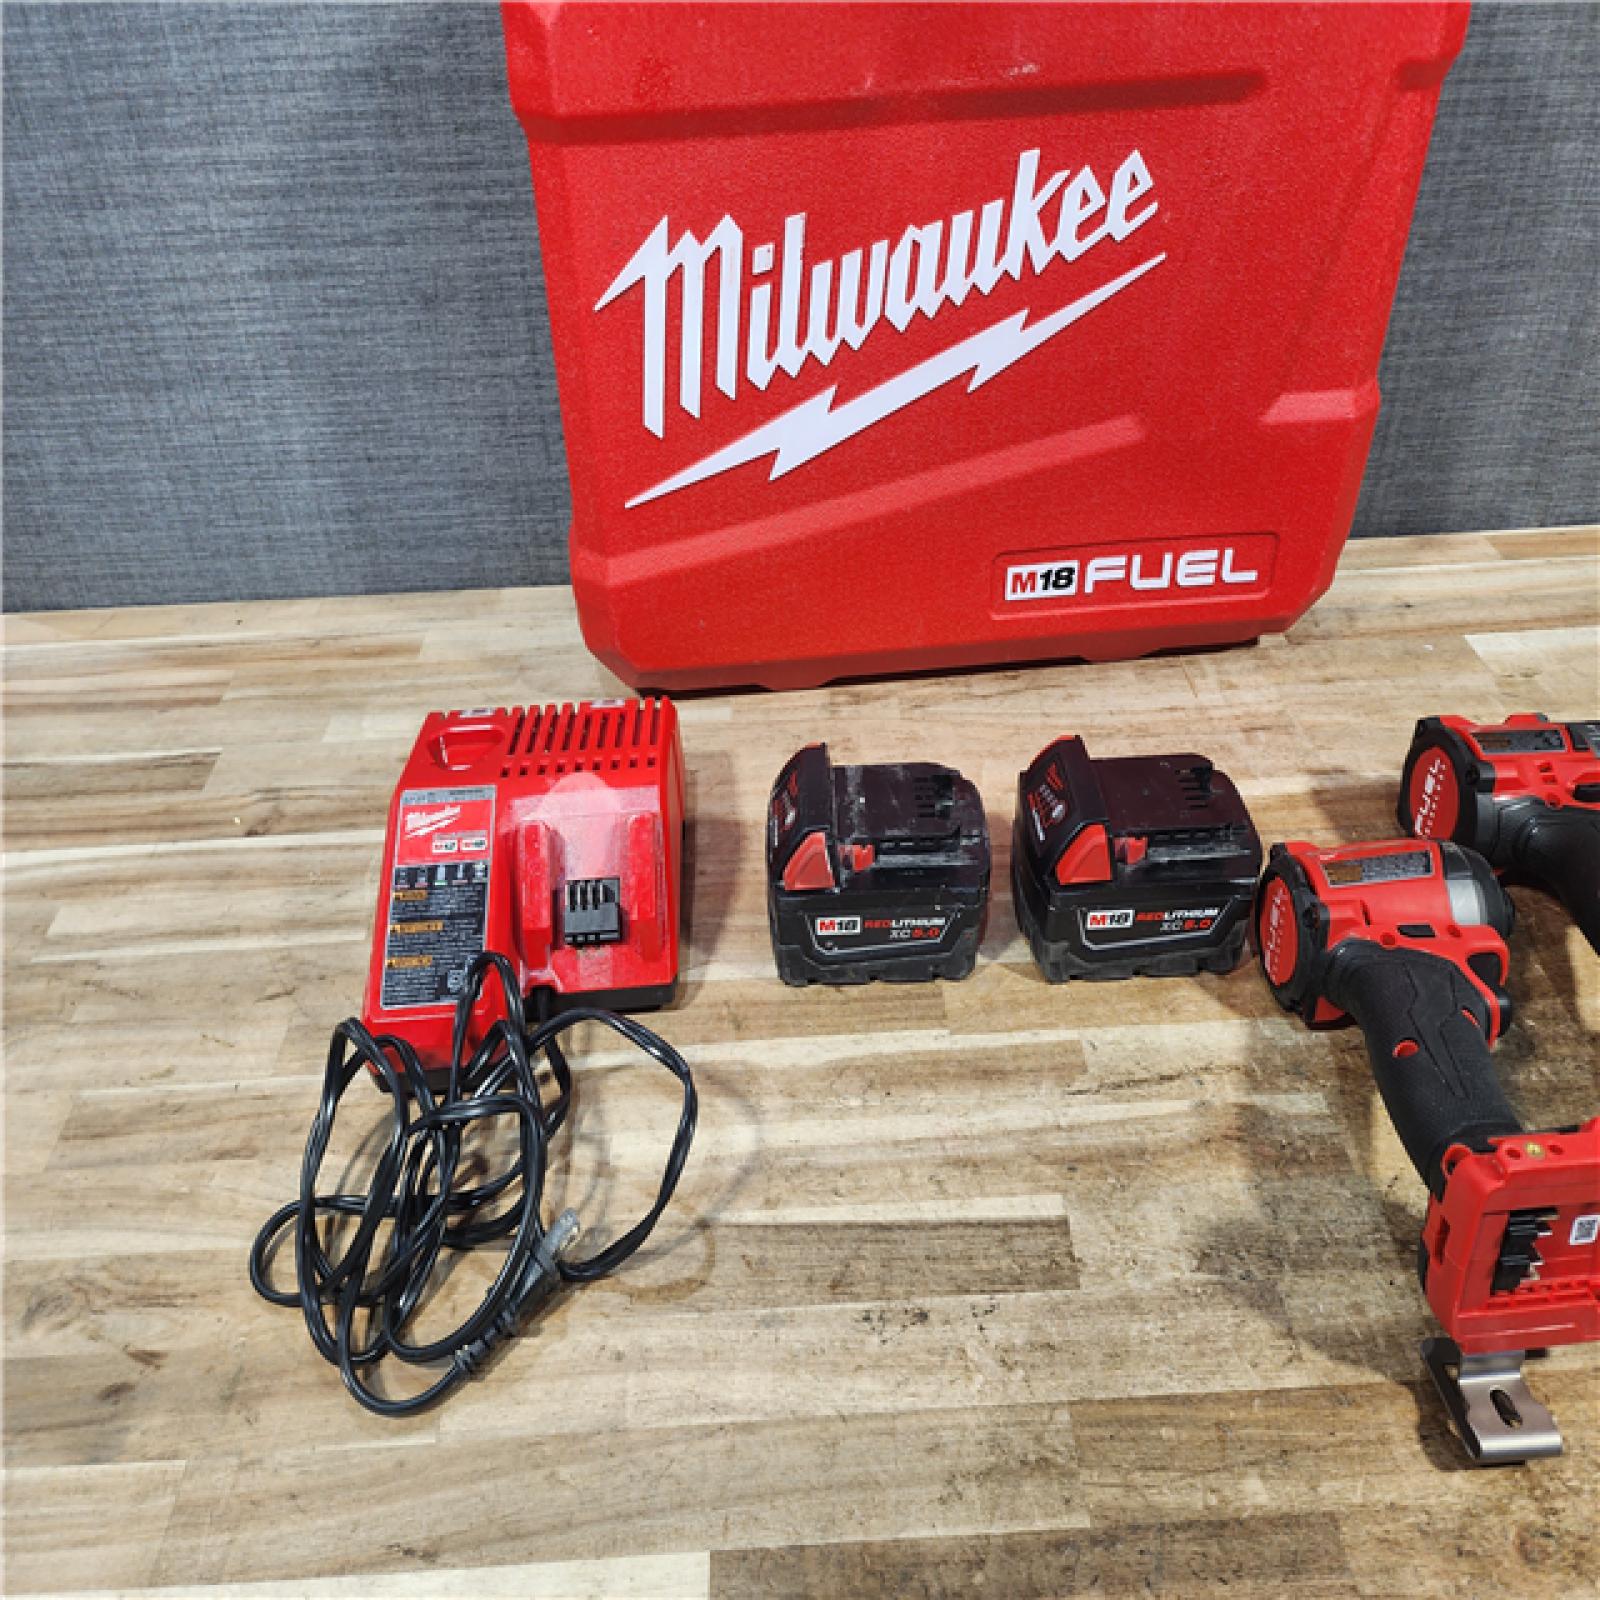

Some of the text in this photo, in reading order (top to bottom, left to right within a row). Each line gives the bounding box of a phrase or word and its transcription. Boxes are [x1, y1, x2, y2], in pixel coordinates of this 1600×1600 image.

[594, 149, 1159, 439] Milwaukee
[1010, 548, 1258, 594] M18 FUEL
[818, 917, 859, 933] M18
[1089, 911, 1132, 928] M18
